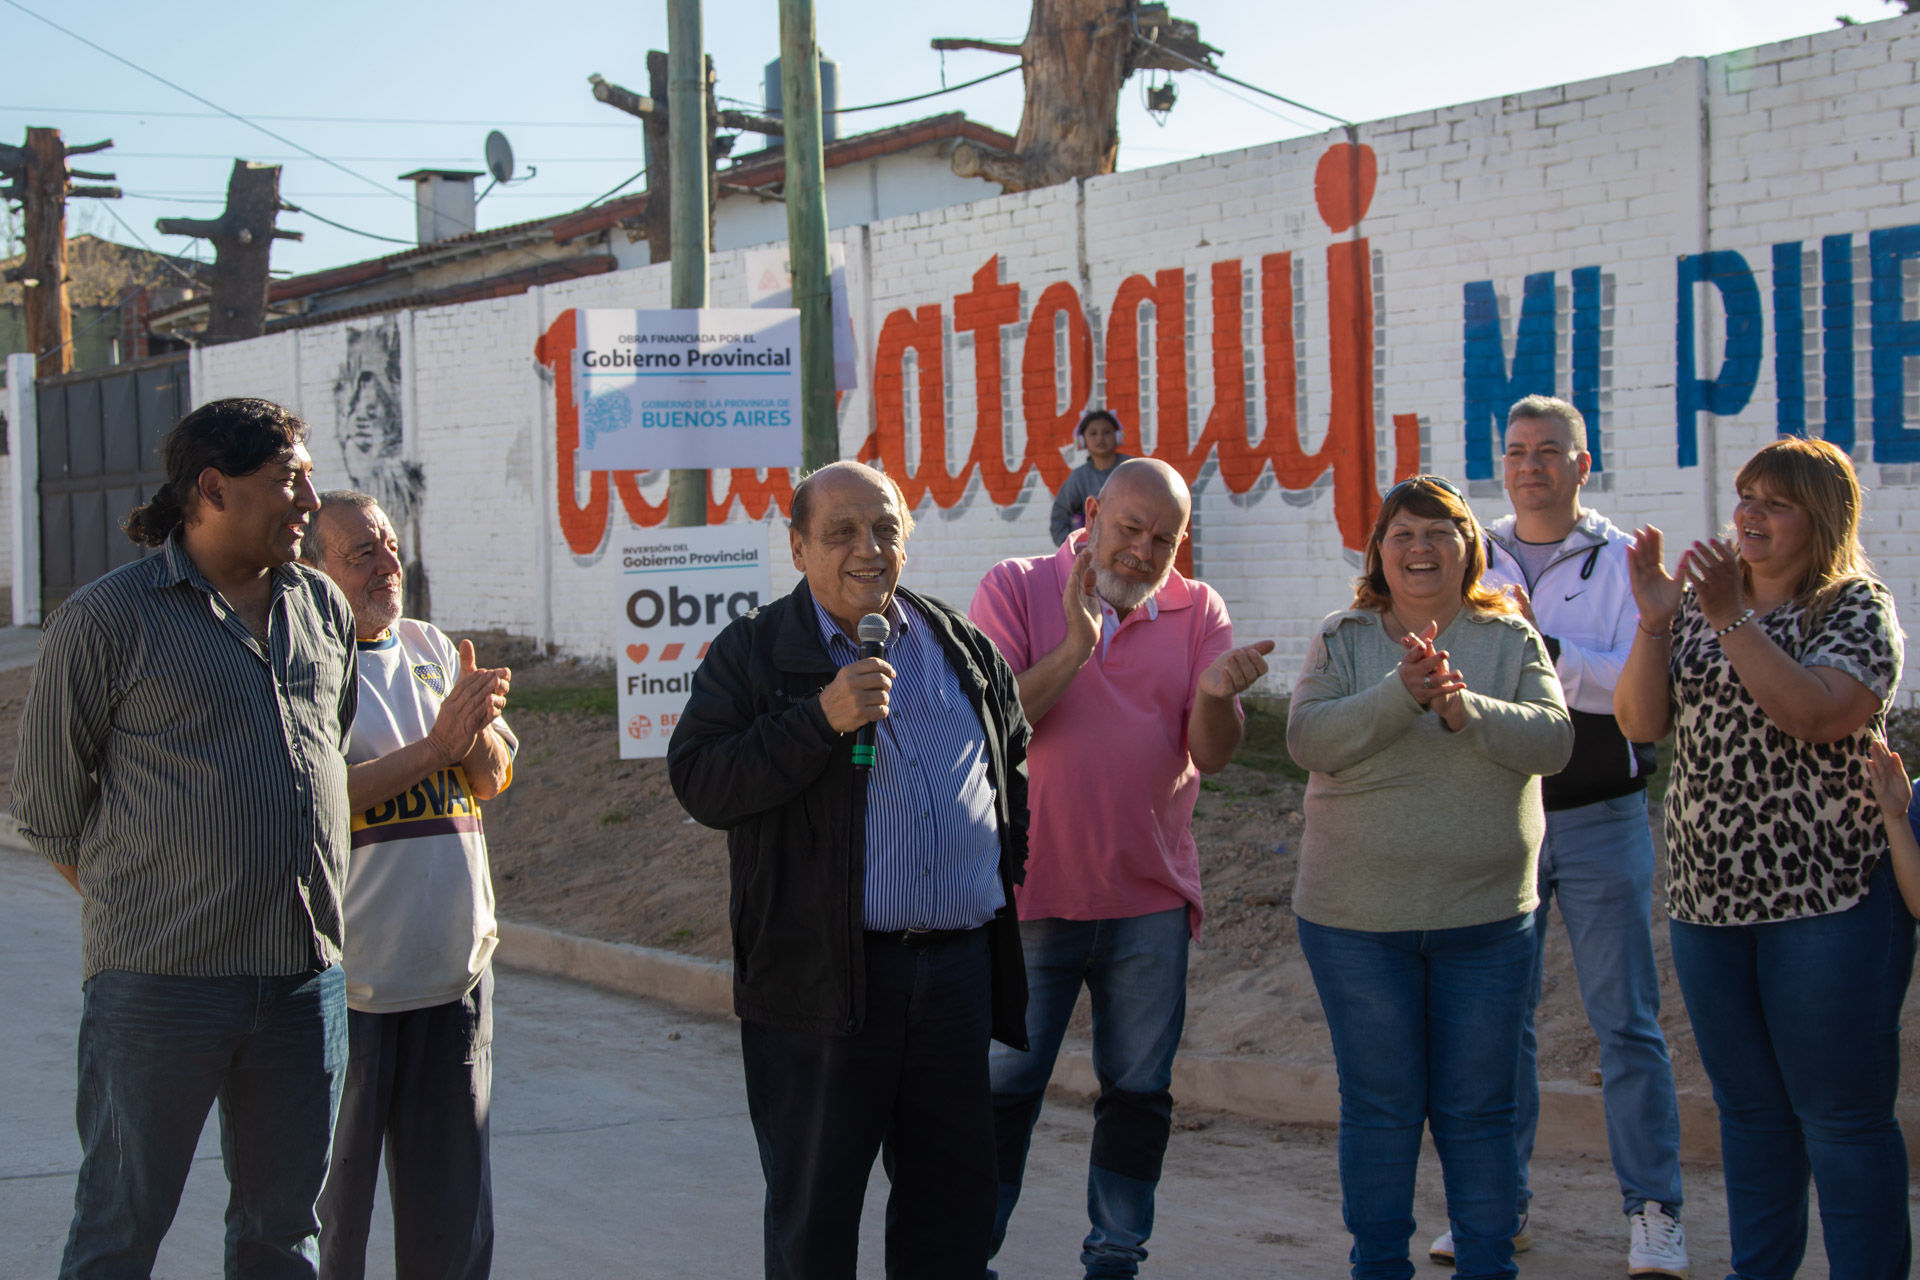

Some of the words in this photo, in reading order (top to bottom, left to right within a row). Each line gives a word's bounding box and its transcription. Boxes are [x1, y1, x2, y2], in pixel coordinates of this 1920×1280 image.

[617, 334, 649, 344] OBRA
[650, 333, 717, 344] FINANCIADA
[719, 333, 742, 344] POR
[743, 333, 757, 344] EL
[582, 348, 682, 368] Gobierno
[686, 346, 790, 368] Provincial
[1464, 265, 1602, 480] MI
[641, 400, 693, 410] GOBIERNO
[694, 400, 707, 409] DE
[709, 399, 722, 409] LA
[724, 399, 775, 409] PROVINCIA
[777, 398, 790, 408] DE
[641, 410, 728, 429] BUENOS
[732, 409, 792, 428] AIRES
[622, 543, 672, 556] INVERSIÓN
[672, 543, 690, 553] DEL
[623, 554, 687, 568] Gobierno
[689, 548, 759, 565] Provincial
[627, 671, 696, 696] Final
